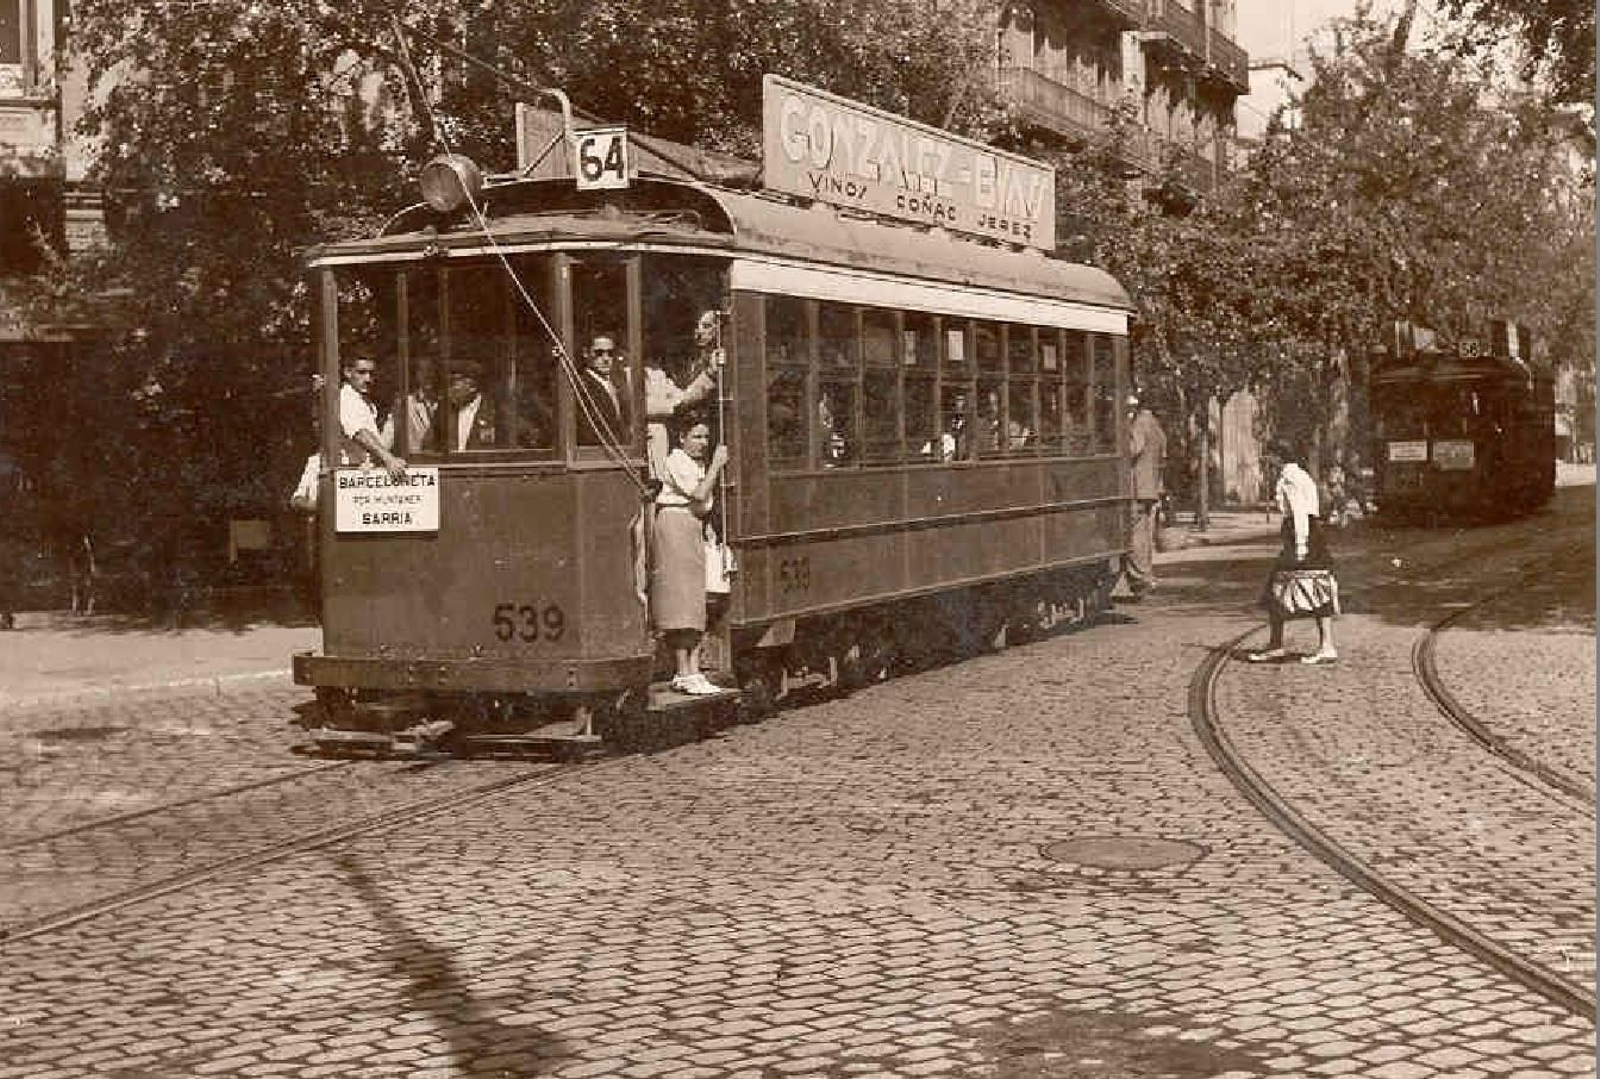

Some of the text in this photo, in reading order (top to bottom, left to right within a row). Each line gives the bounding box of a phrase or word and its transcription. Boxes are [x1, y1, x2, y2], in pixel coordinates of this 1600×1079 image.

[580, 136, 624, 182] 64
[896, 194, 956, 221] COÑAC
[978, 213, 1032, 240] JEREZ
[493, 602, 565, 643] 539
